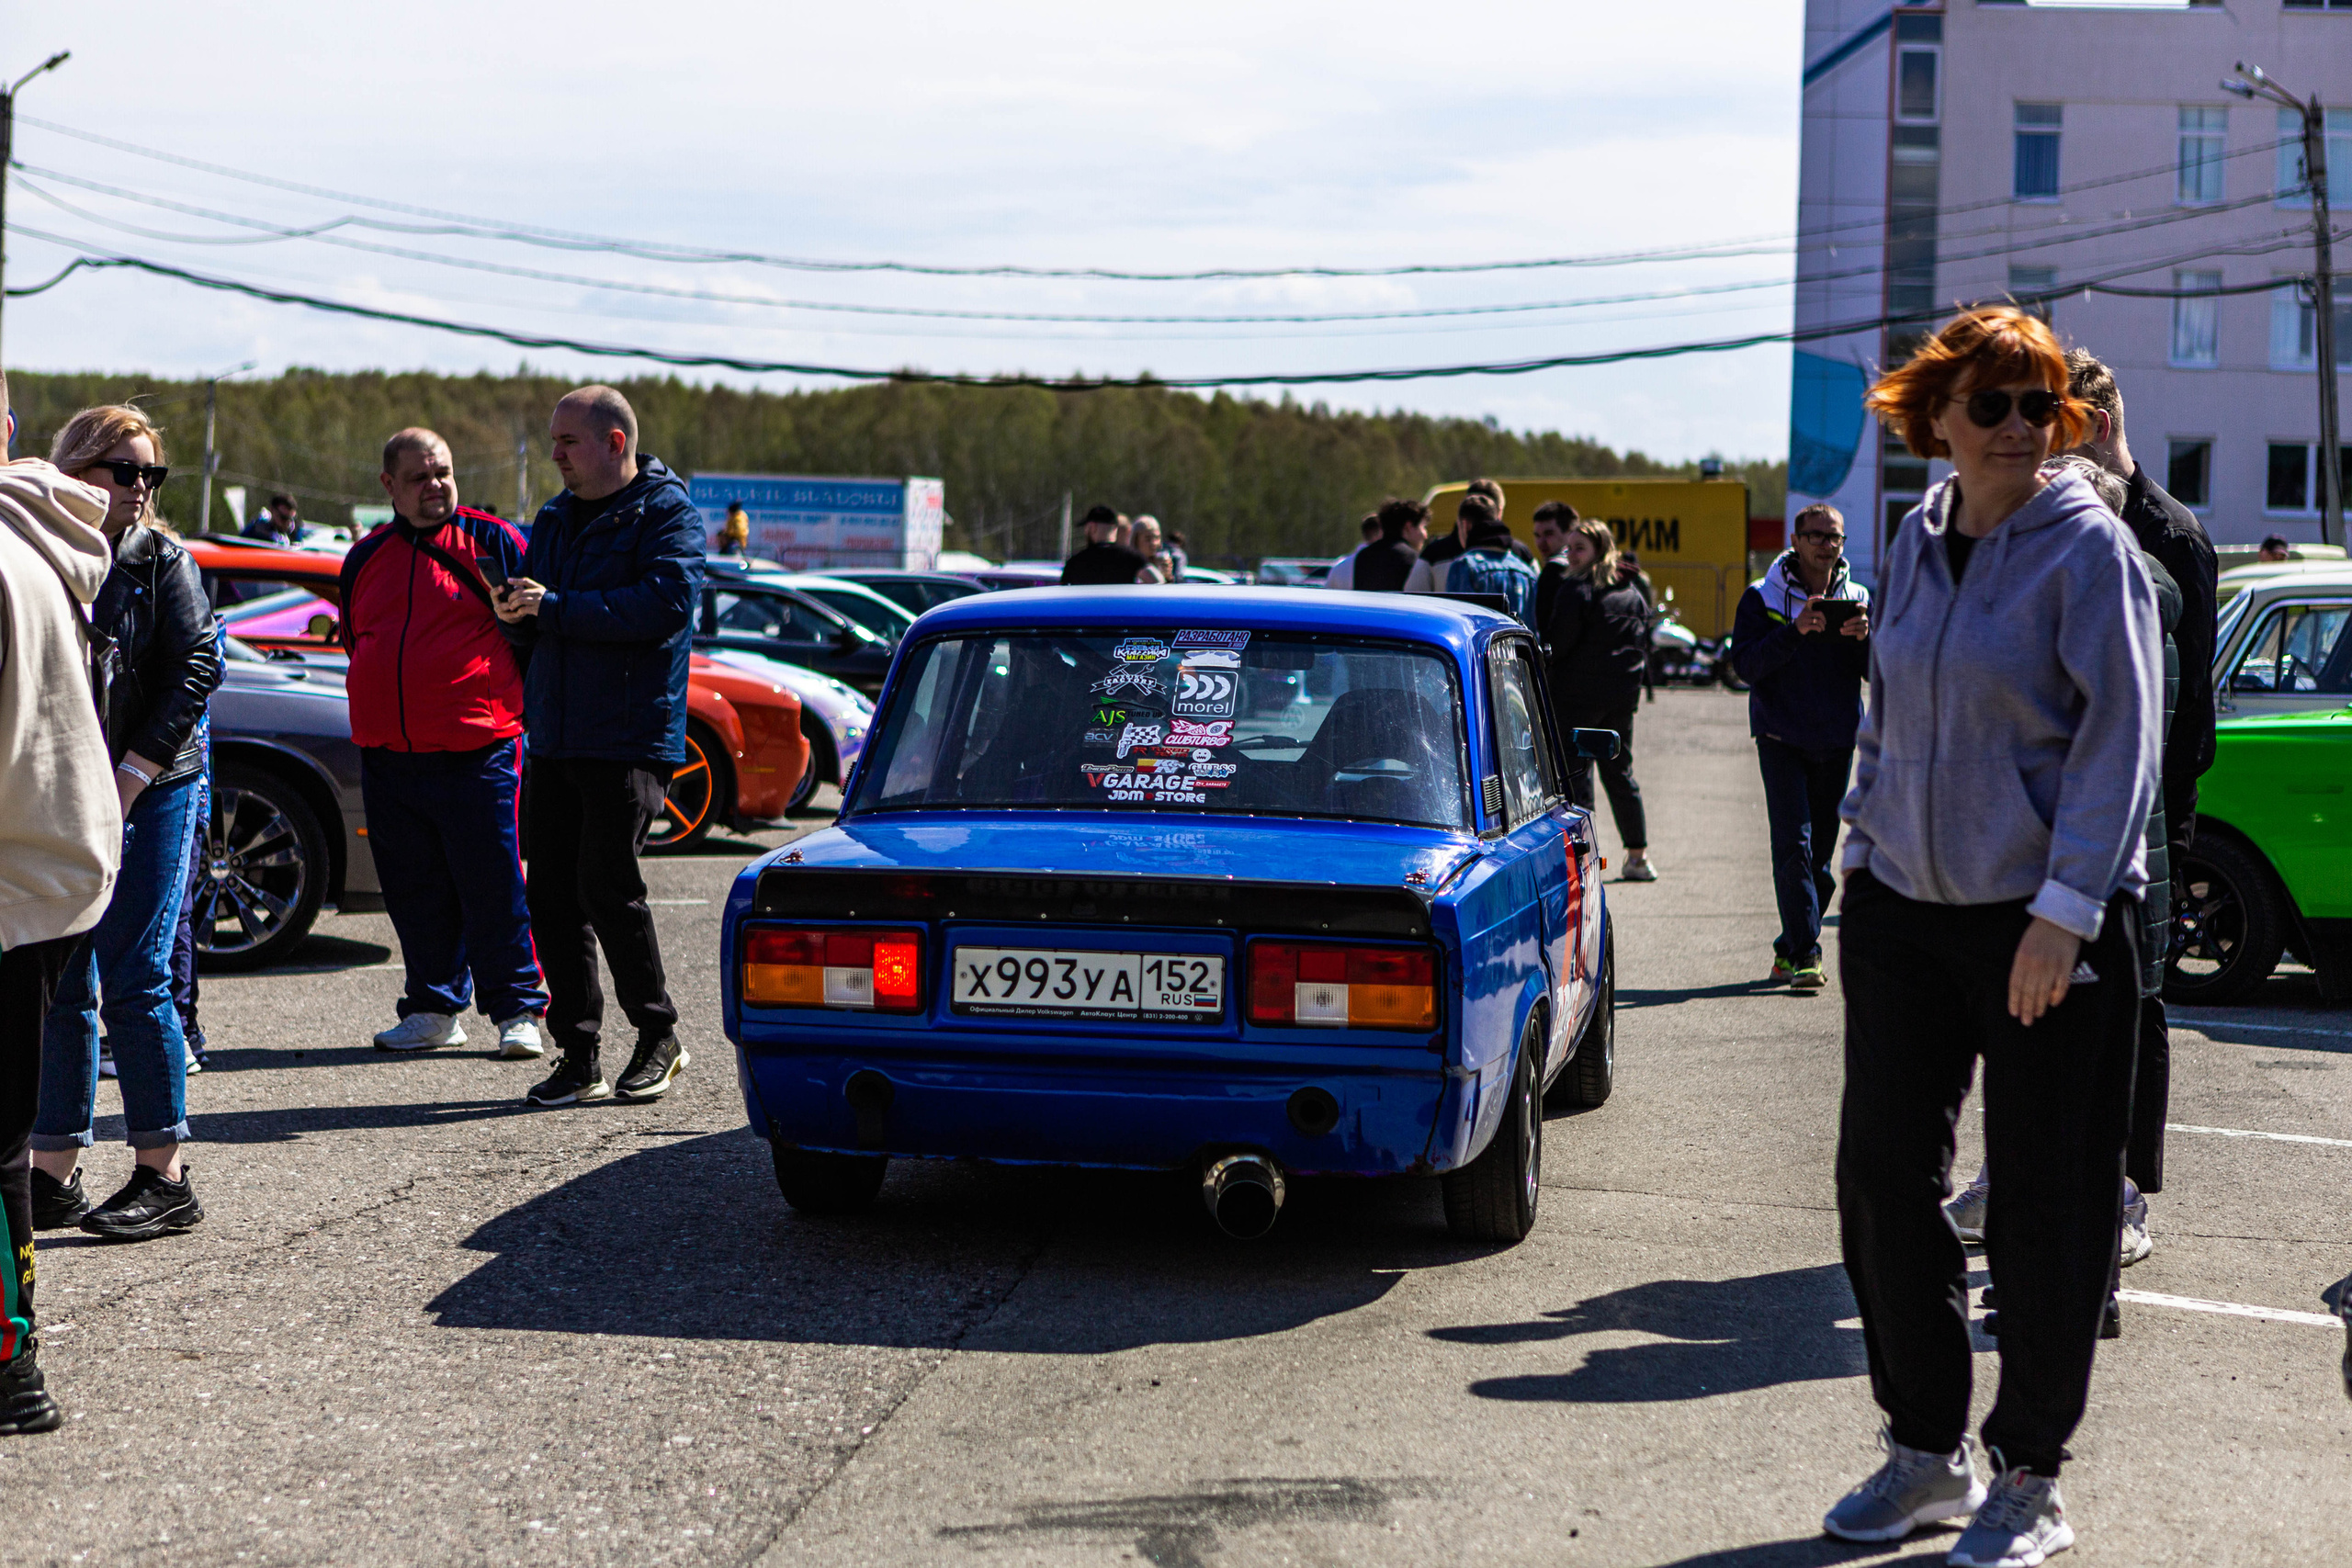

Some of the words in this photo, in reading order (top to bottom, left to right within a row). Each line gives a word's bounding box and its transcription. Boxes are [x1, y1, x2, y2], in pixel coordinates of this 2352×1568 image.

[1178, 630, 1250, 642] РАЗРАБОТАНО
[1106, 677, 1155, 685] FACTORY
[1177, 702, 1229, 714] morel
[1091, 710, 1126, 727] AJS
[1084, 732, 1114, 740] acv
[1166, 735, 1230, 746] CLUBTURBO
[1191, 763, 1236, 773] GUESS
[1107, 790, 1144, 801] JDM
[1154, 791, 1206, 804] STORE
[1146, 959, 1209, 993] 152
[1160, 993, 1193, 1006] RUS
[969, 1005, 1015, 1014] Официальный
[1015, 1007, 1036, 1015] Дилер
[1036, 1008, 1074, 1016] Volkswagen
[1080, 1010, 1115, 1018] АвтоКлаус
